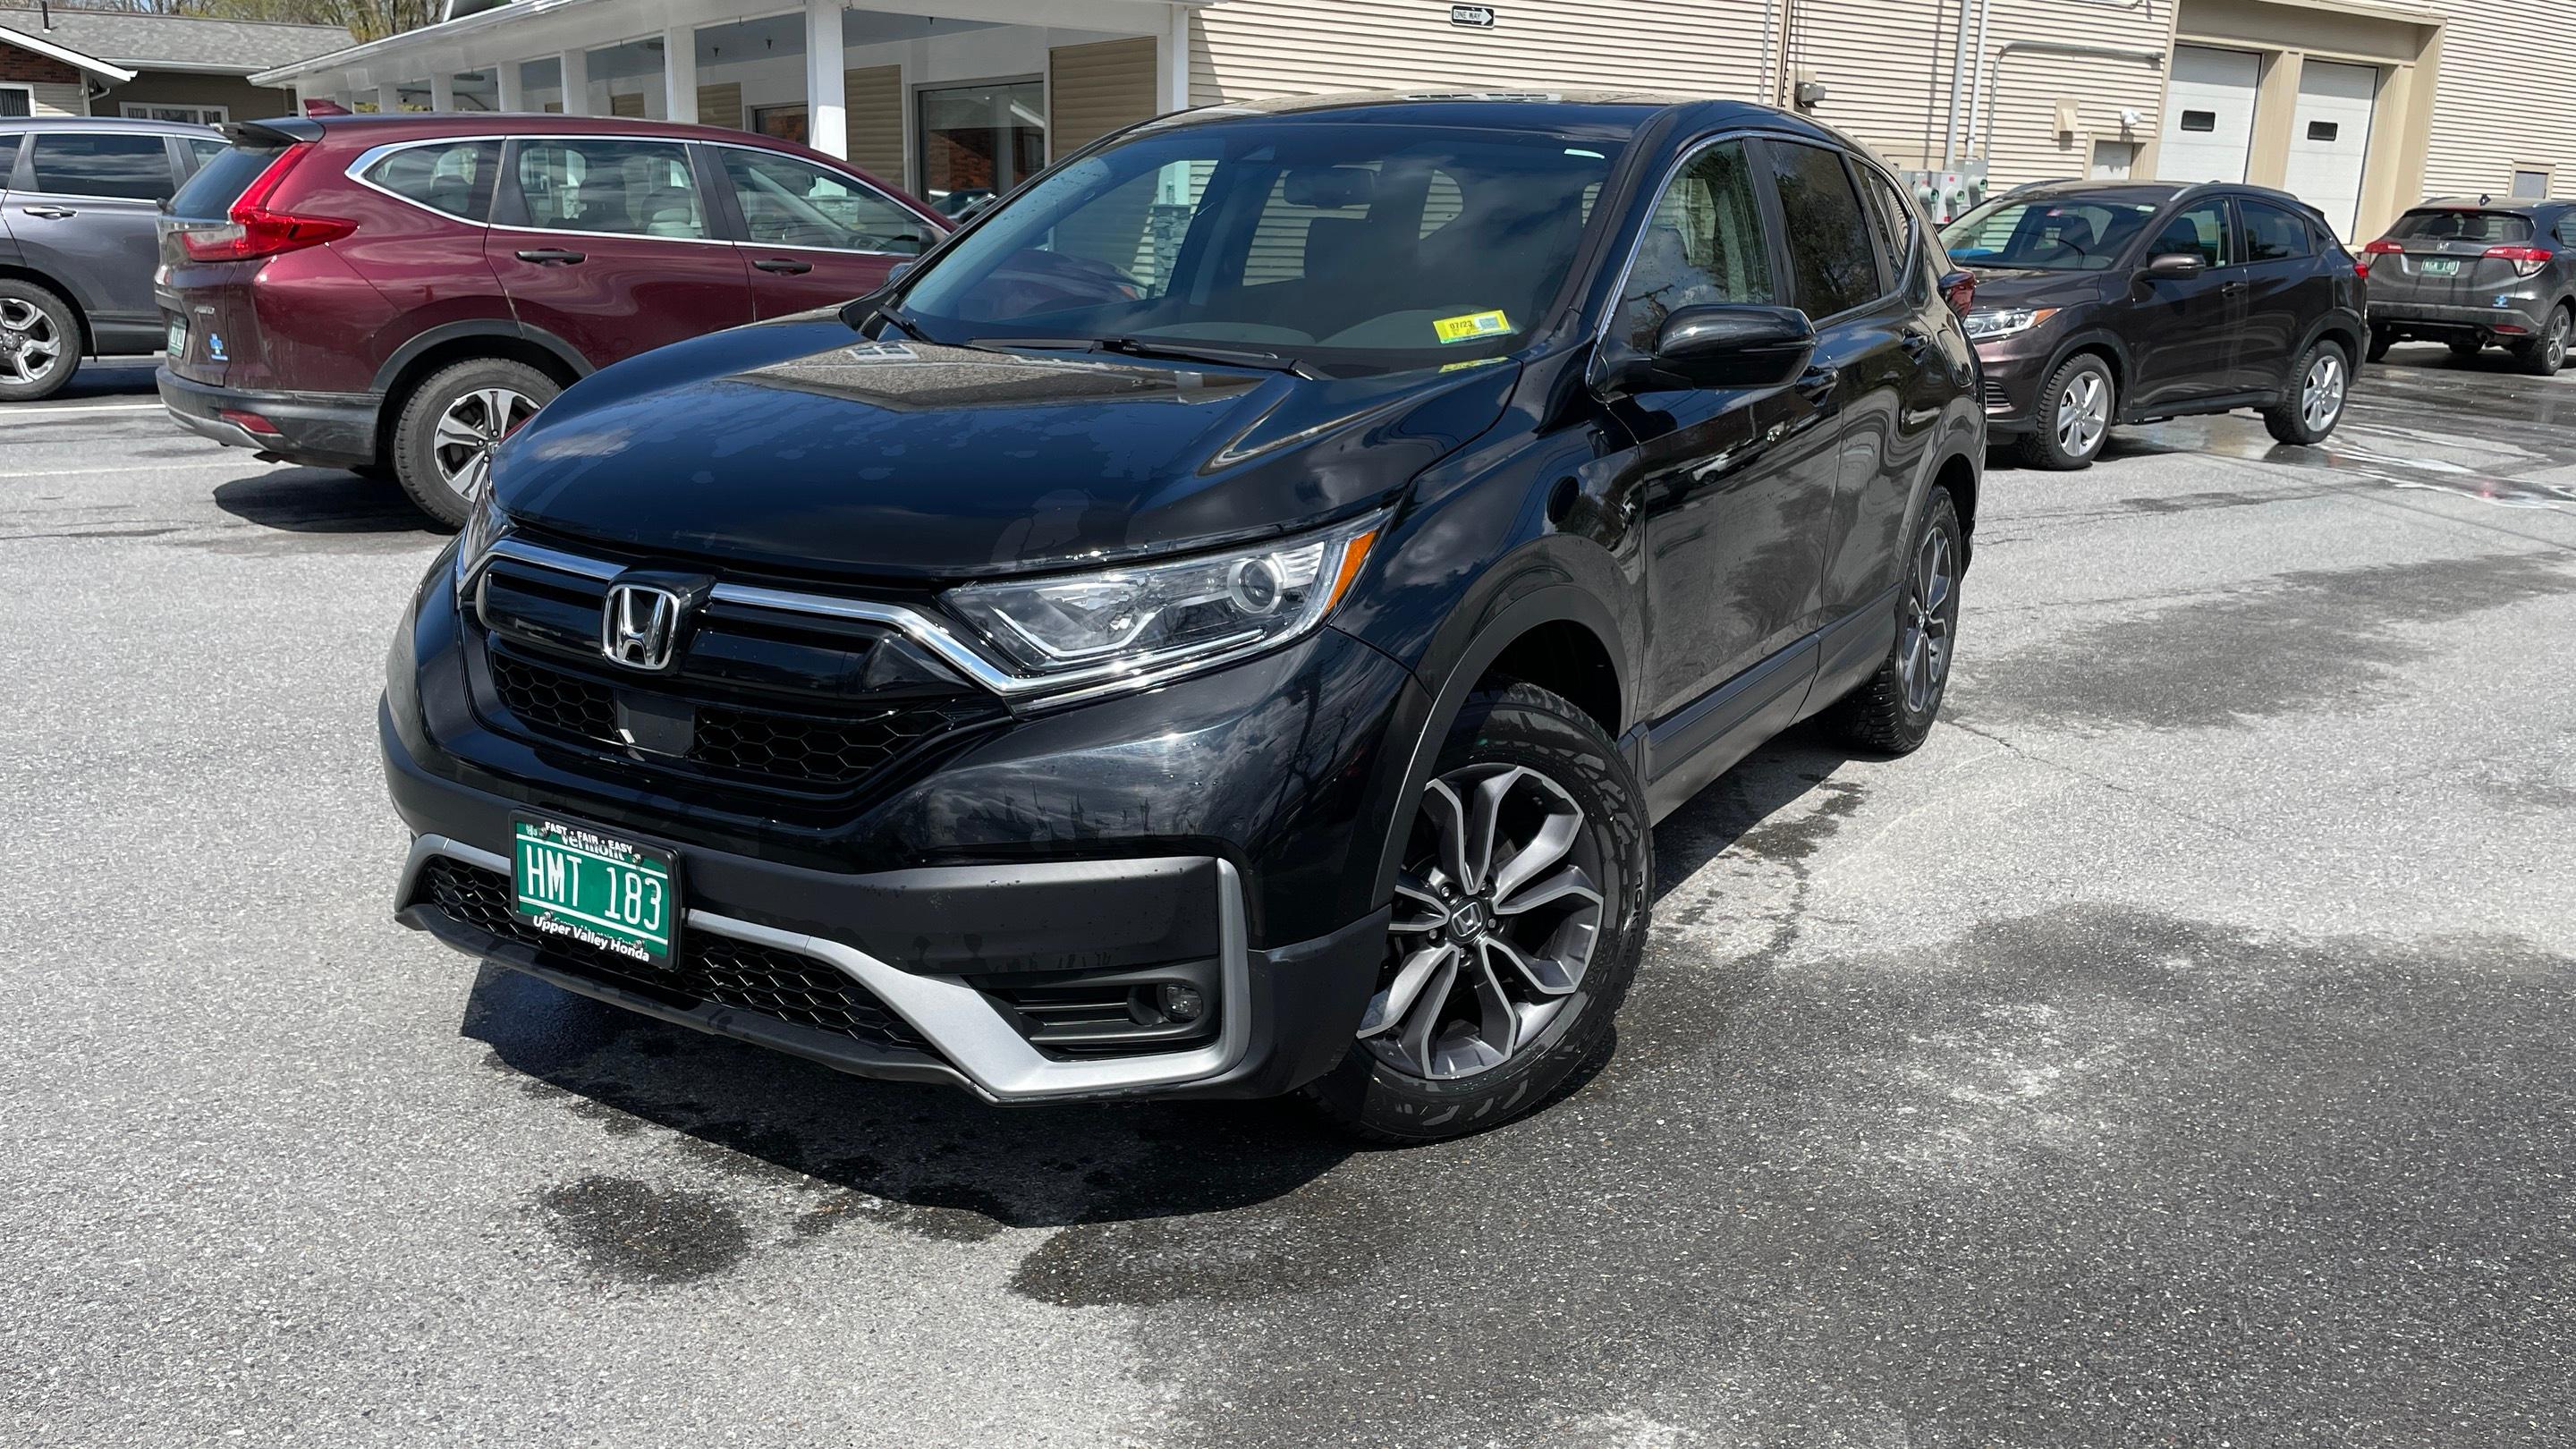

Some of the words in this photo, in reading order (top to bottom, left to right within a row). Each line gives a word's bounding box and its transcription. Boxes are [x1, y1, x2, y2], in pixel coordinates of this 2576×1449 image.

[1454, 11, 1468, 19] ONE
[1469, 12, 1481, 20] WAY
[1449, 320, 1473, 329] 07/23
[545, 821, 568, 835] FAST
[577, 831, 598, 844] FAIR
[608, 840, 633, 854] EASY
[526, 844, 582, 907] HMT
[605, 867, 663, 931] 183
[533, 915, 572, 935] Upper
[573, 926, 608, 950] Valley
[611, 938, 650, 962] Honda
